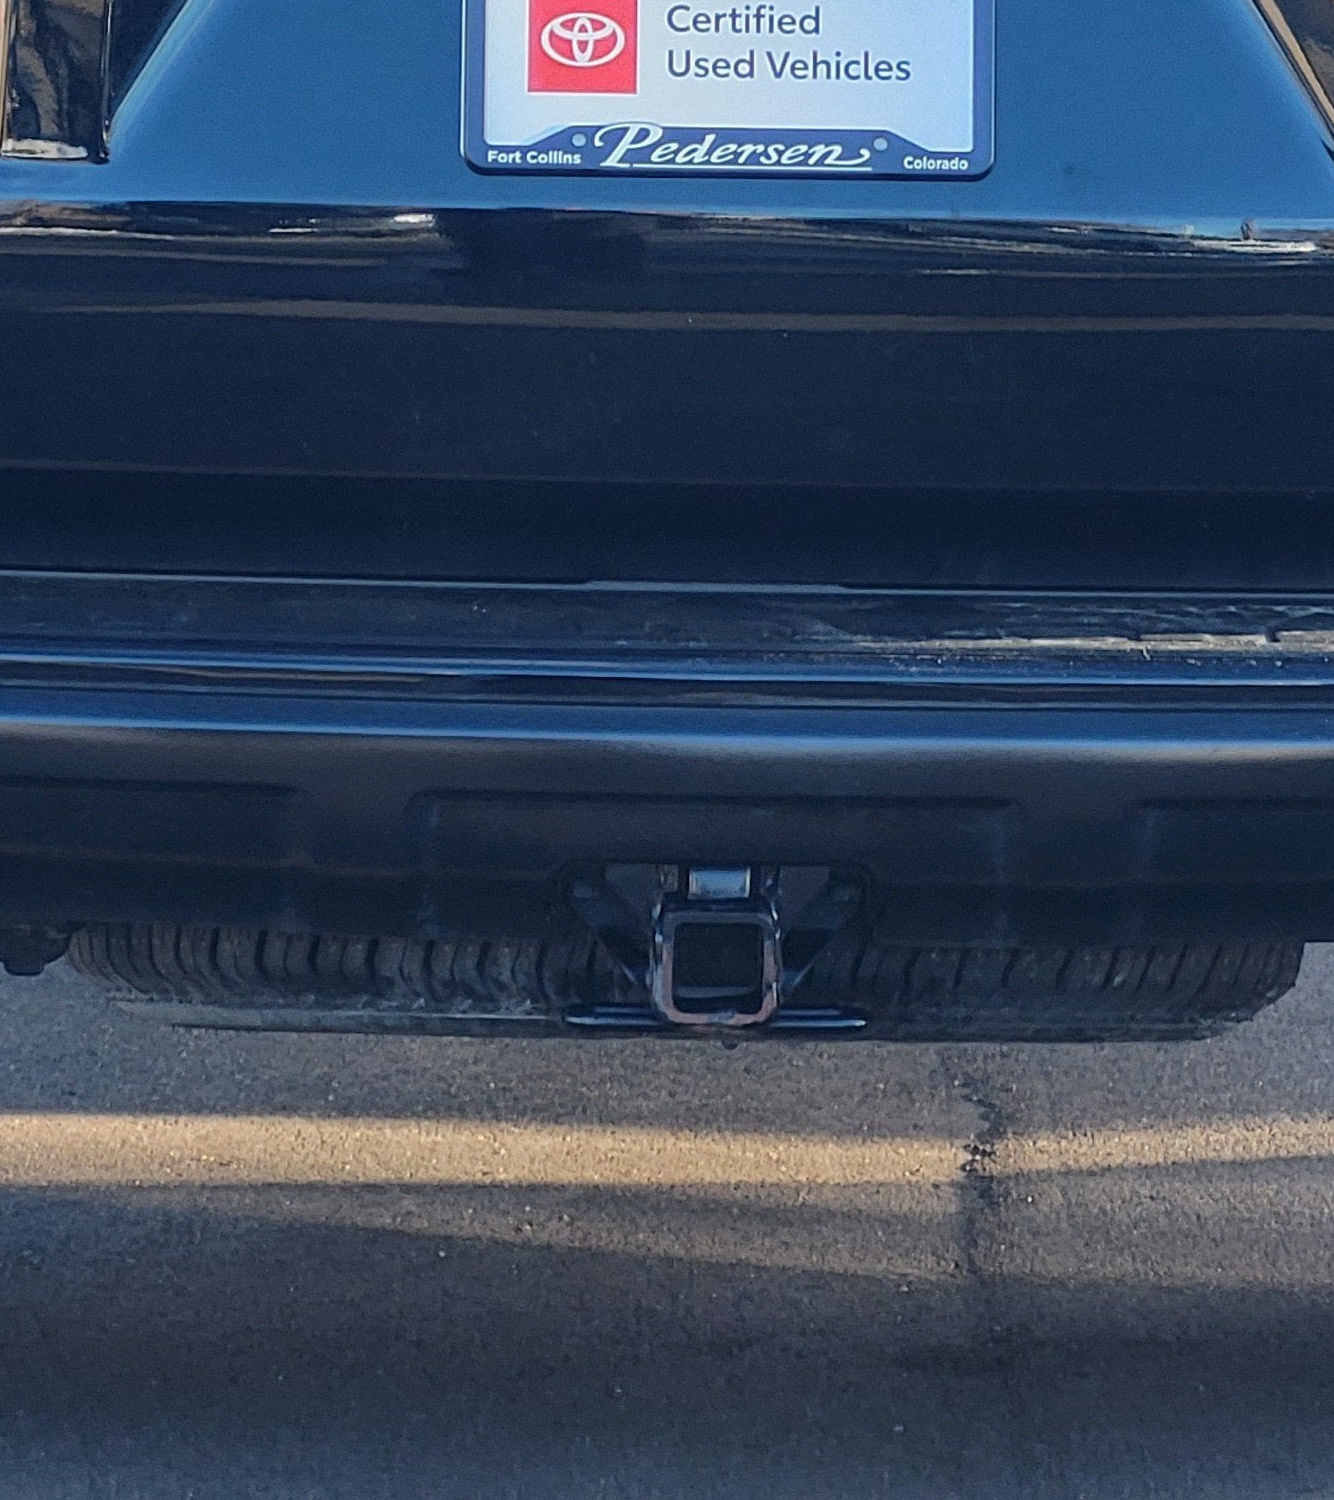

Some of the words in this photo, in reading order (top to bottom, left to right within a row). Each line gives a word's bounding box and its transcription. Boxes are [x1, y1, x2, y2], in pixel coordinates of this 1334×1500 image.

[666, 3, 821, 36] Certified
[666, 49, 756, 80] Used
[764, 50, 912, 82] Vehicles
[486, 150, 522, 165] Fort
[525, 150, 582, 165] Collins
[593, 121, 872, 169] Pedersen
[902, 155, 970, 172] Colorado
